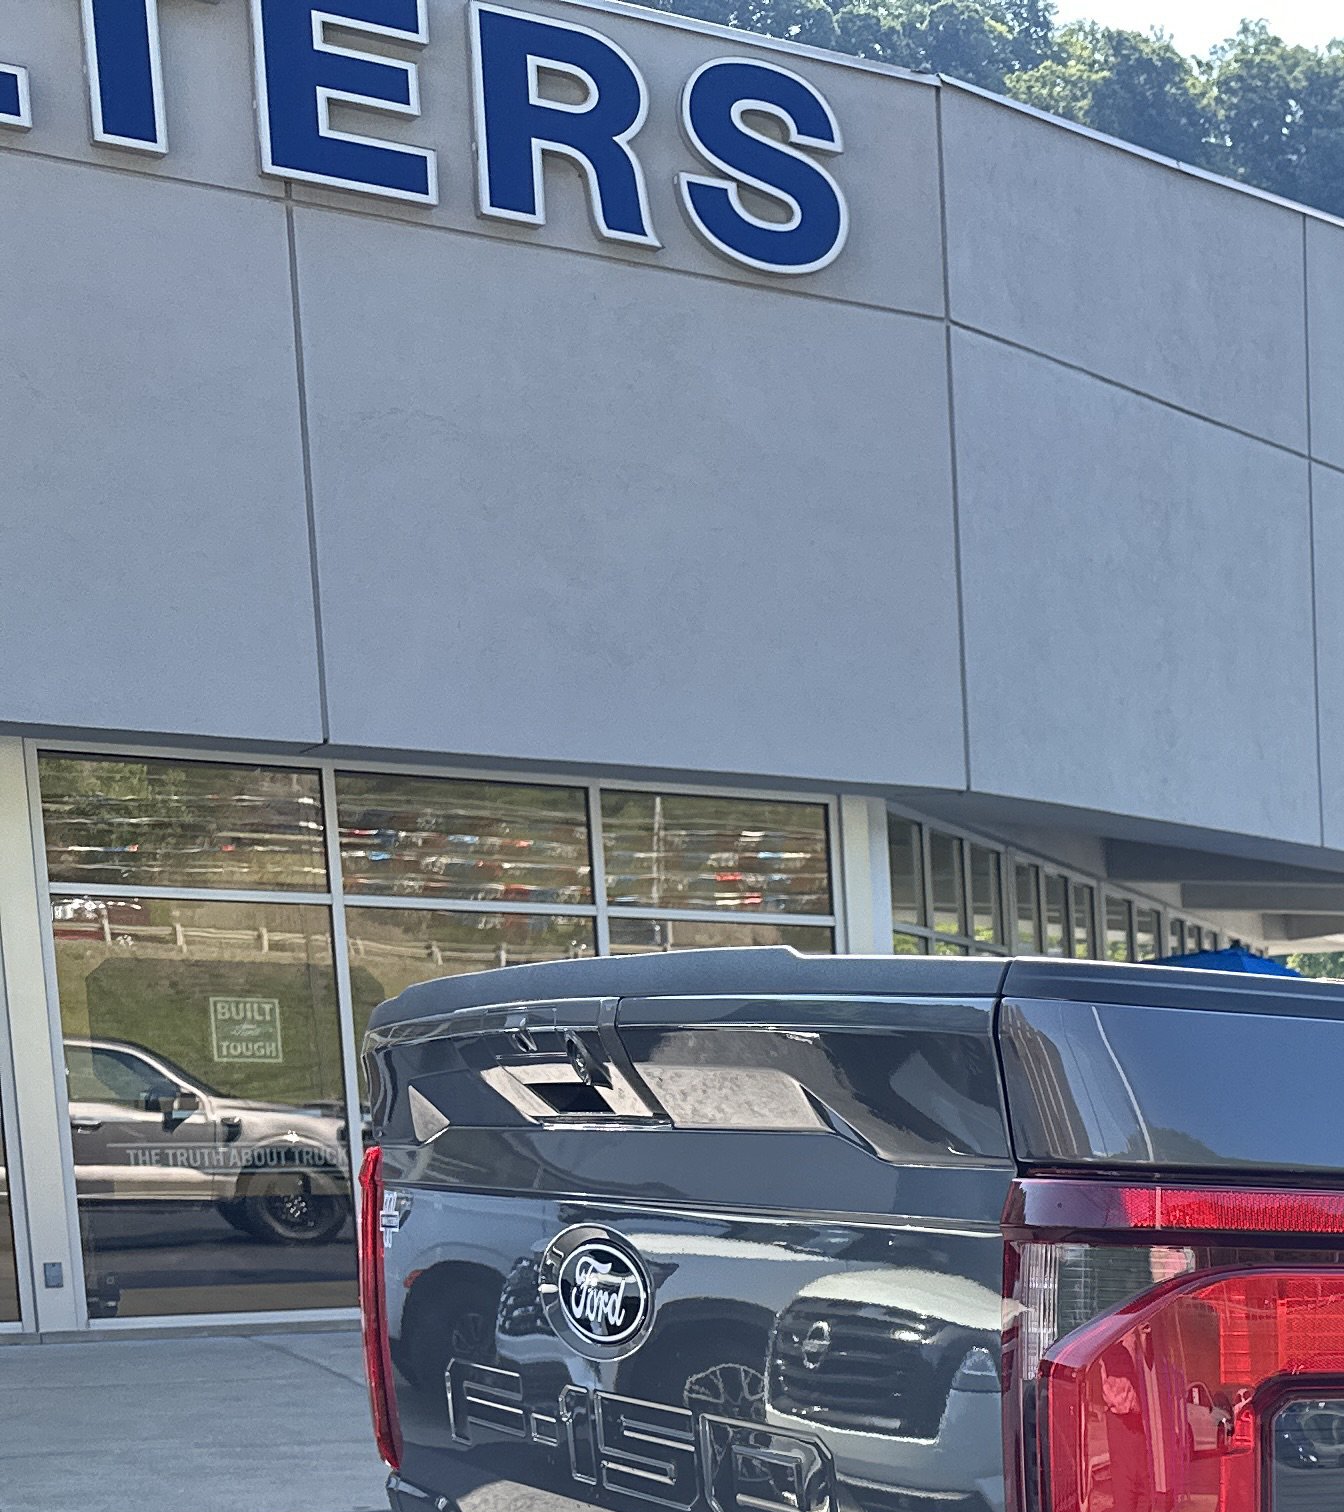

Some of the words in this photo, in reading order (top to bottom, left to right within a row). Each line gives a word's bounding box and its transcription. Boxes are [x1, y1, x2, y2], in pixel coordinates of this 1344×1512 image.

[0, 0, 850, 276] TERS
[216, 1002, 273, 1021] BUILT
[220, 1041, 277, 1057] TOUGH
[126, 1148, 161, 1166] THE
[164, 1148, 225, 1167] TRUTH
[228, 1147, 287, 1167] ABOUT
[571, 1256, 626, 1327] Ford
